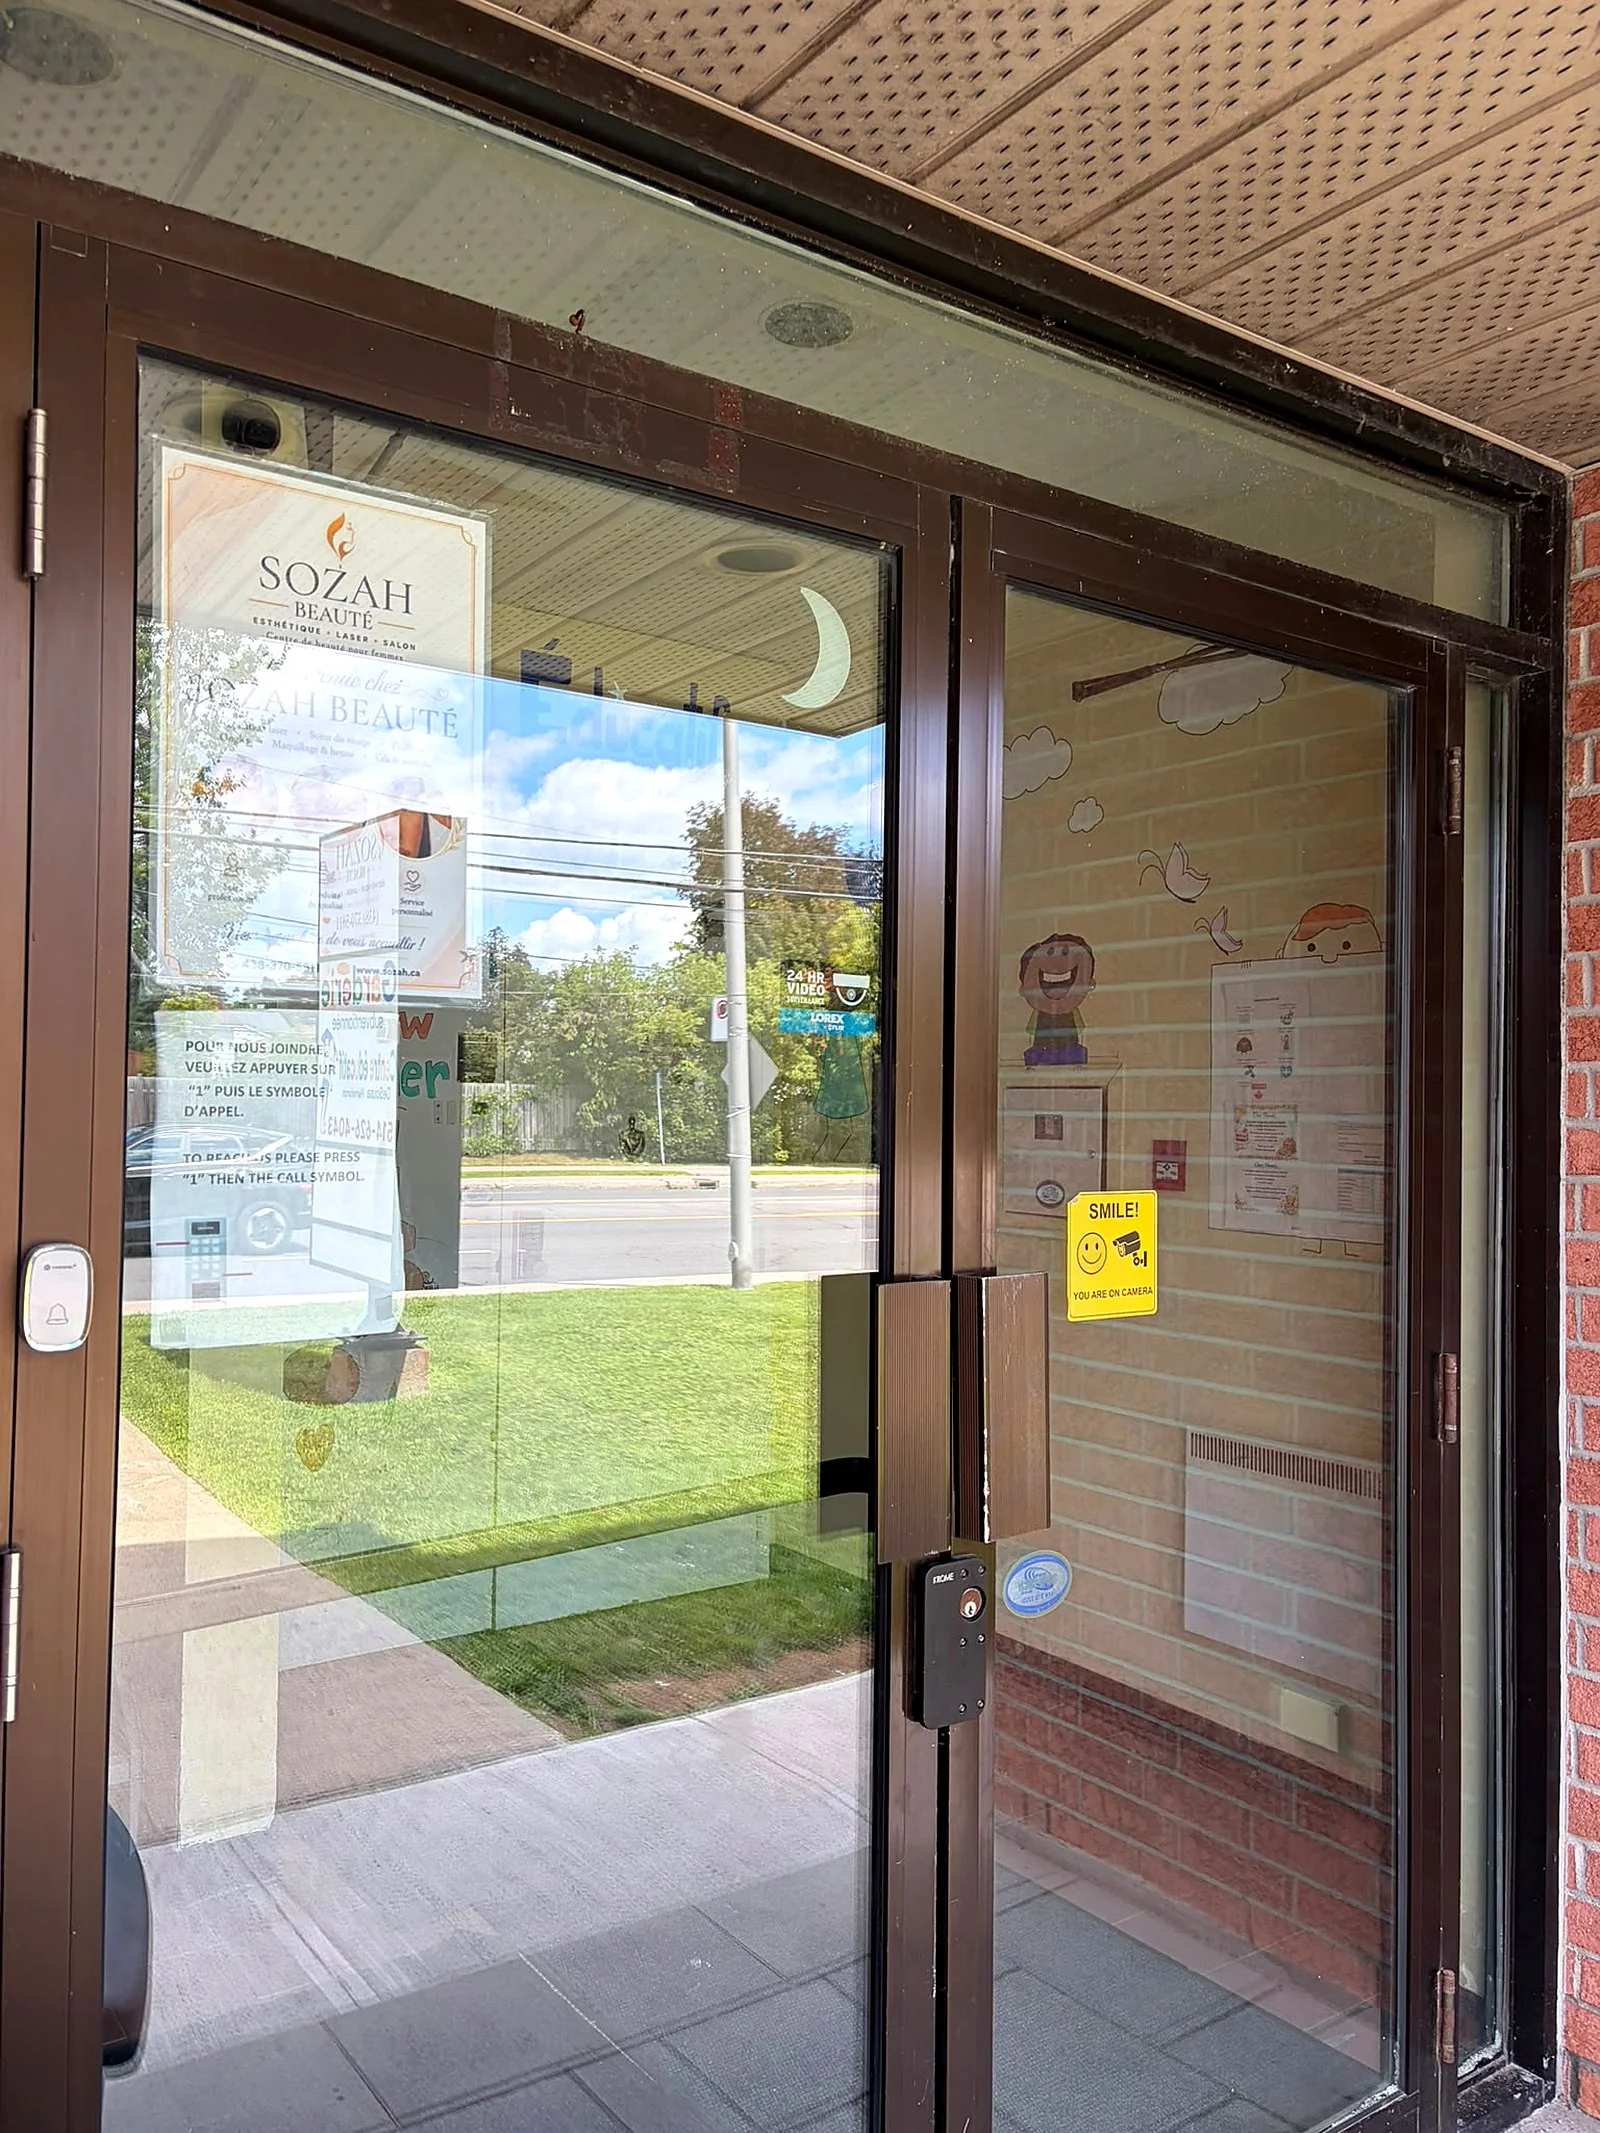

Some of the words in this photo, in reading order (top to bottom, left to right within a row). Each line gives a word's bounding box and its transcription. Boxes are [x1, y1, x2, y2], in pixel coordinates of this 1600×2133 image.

[259, 555, 414, 615] SOZAH
[294, 601, 374, 631] BEAUTÉ
[252, 616, 321, 635] ESTHÉTIQUE
[335, 631, 369, 643] LASER
[382, 639, 416, 651] SALON
[330, 694, 458, 739] BEAUTÉ
[786, 969, 803, 981] 24
[807, 970, 825, 984] HR
[786, 982, 826, 996] VIDEO
[810, 1012, 845, 1025] LOREX
[185, 1040, 225, 1052] POUR
[229, 1042, 267, 1055] NOUS
[185, 1061, 247, 1074] VEUILLEZ
[249, 1062, 309, 1075] APPUYER
[311, 1063, 337, 1076] SUR
[214, 1085, 245, 1098] PUIS
[249, 1085, 263, 1098] LE
[266, 1085, 326, 1098] SYMBOLE
[184, 1153, 202, 1163] TO
[275, 1152, 320, 1164] PLEASE
[324, 1151, 360, 1163] PRESS
[208, 1173, 245, 1185] THEN
[249, 1173, 274, 1184] THE
[276, 1172, 307, 1183] CALL
[310, 1170, 365, 1183] SYMBOL.
[1089, 1201, 1139, 1219] SMILE!
[1073, 1291, 1090, 1301] YOU
[1091, 1288, 1108, 1300] ARE
[1109, 1288, 1120, 1298] ON
[1121, 1285, 1154, 1297] CAMERA
